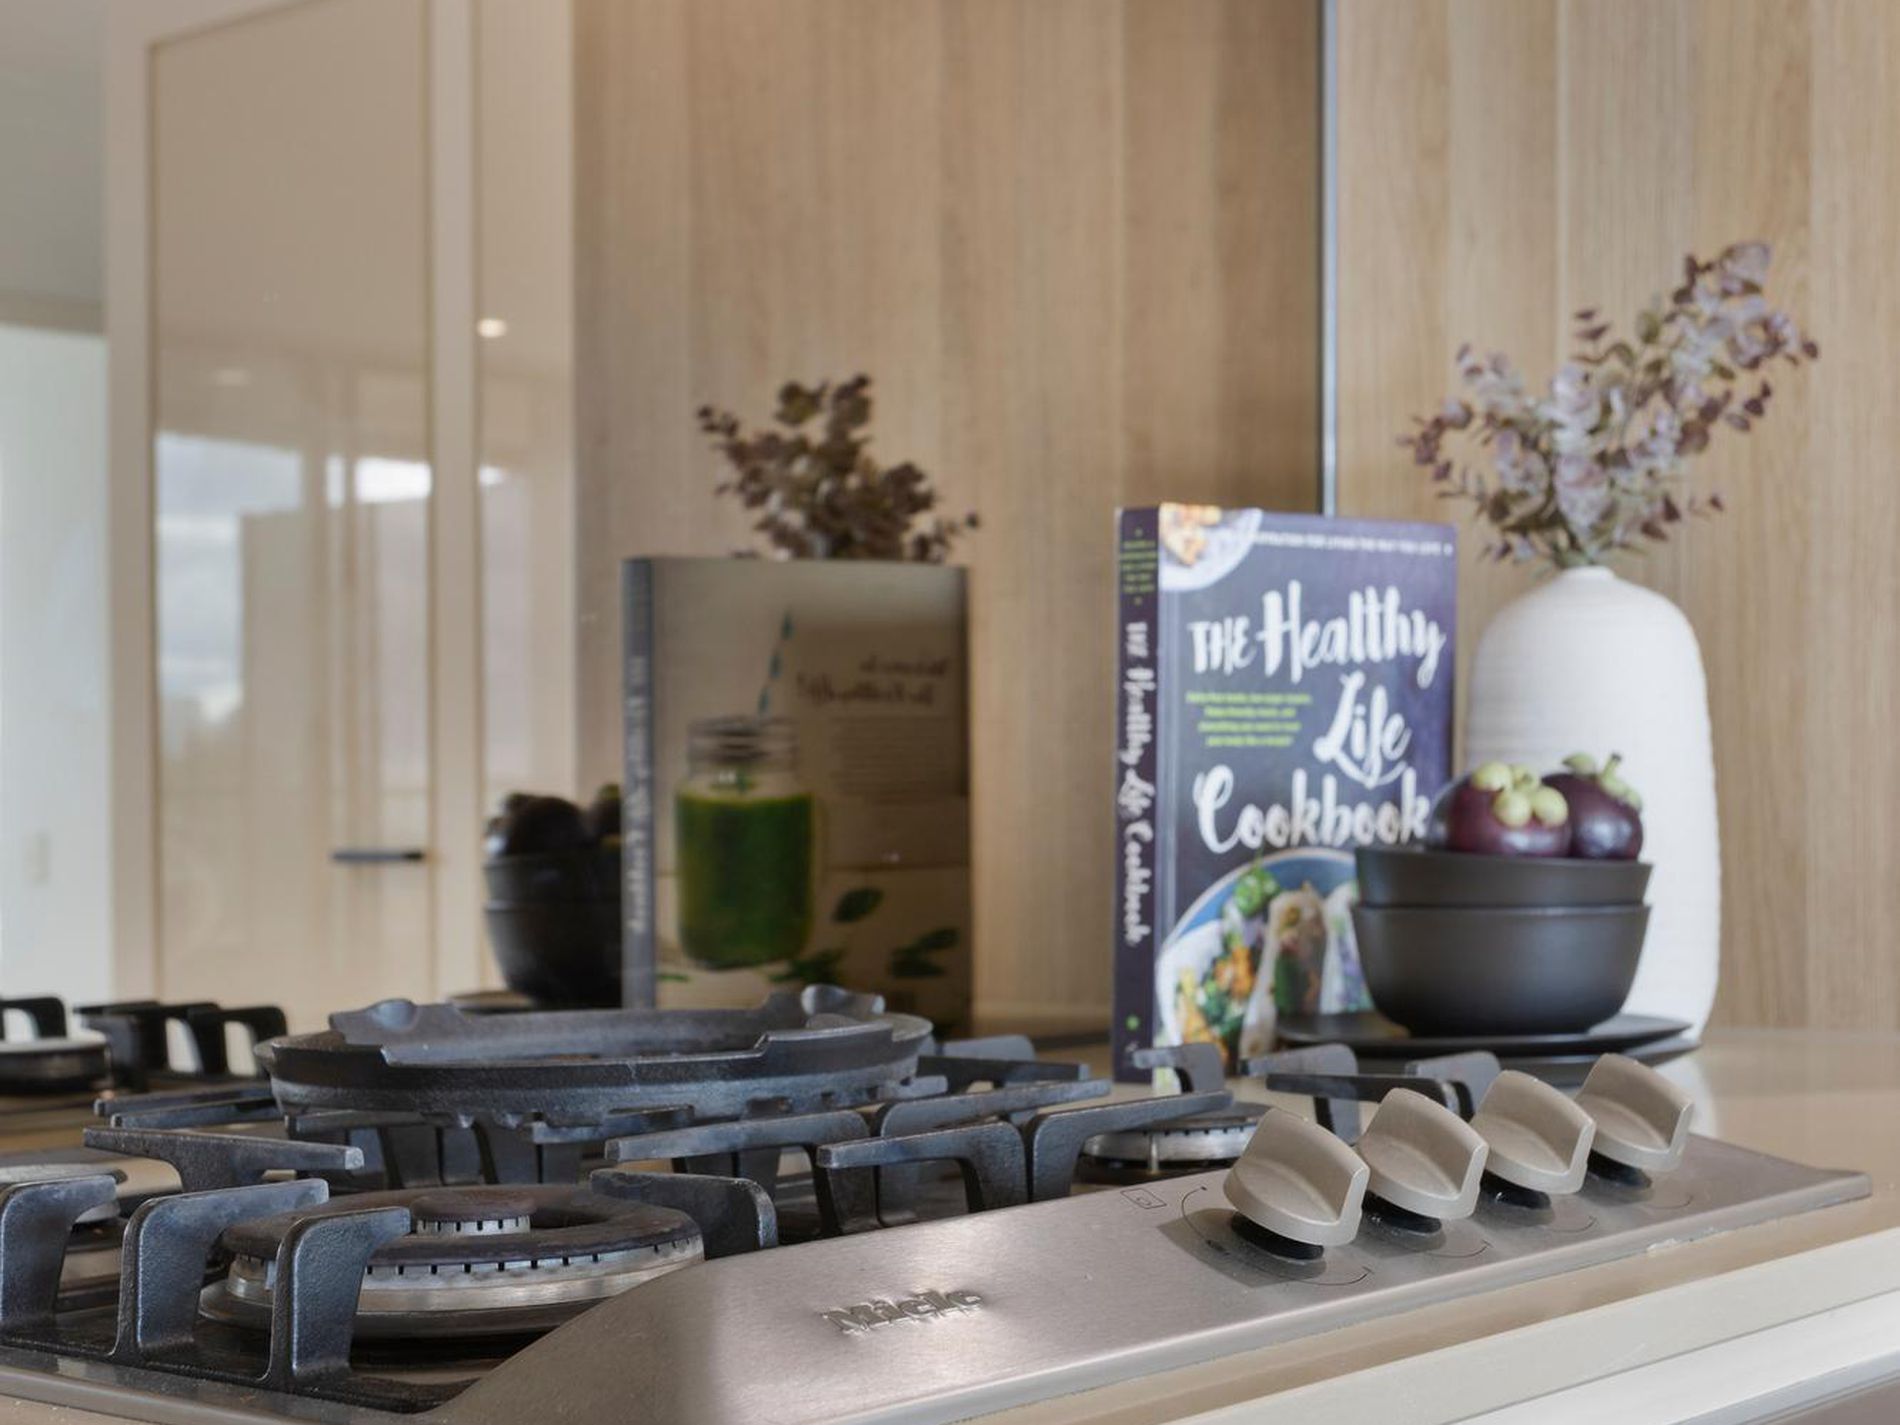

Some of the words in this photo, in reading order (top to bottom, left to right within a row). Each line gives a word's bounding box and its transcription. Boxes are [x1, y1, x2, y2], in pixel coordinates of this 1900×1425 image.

[1187, 616, 1256, 676] THE
[1255, 579, 1447, 690] Healthy
[1119, 666, 1157, 766] Healthy
[1312, 670, 1412, 790] Life
[1192, 764, 1431, 854] Cookbook
[1123, 819, 1155, 946] Cookbook
[820, 1289, 984, 1337] Miele
